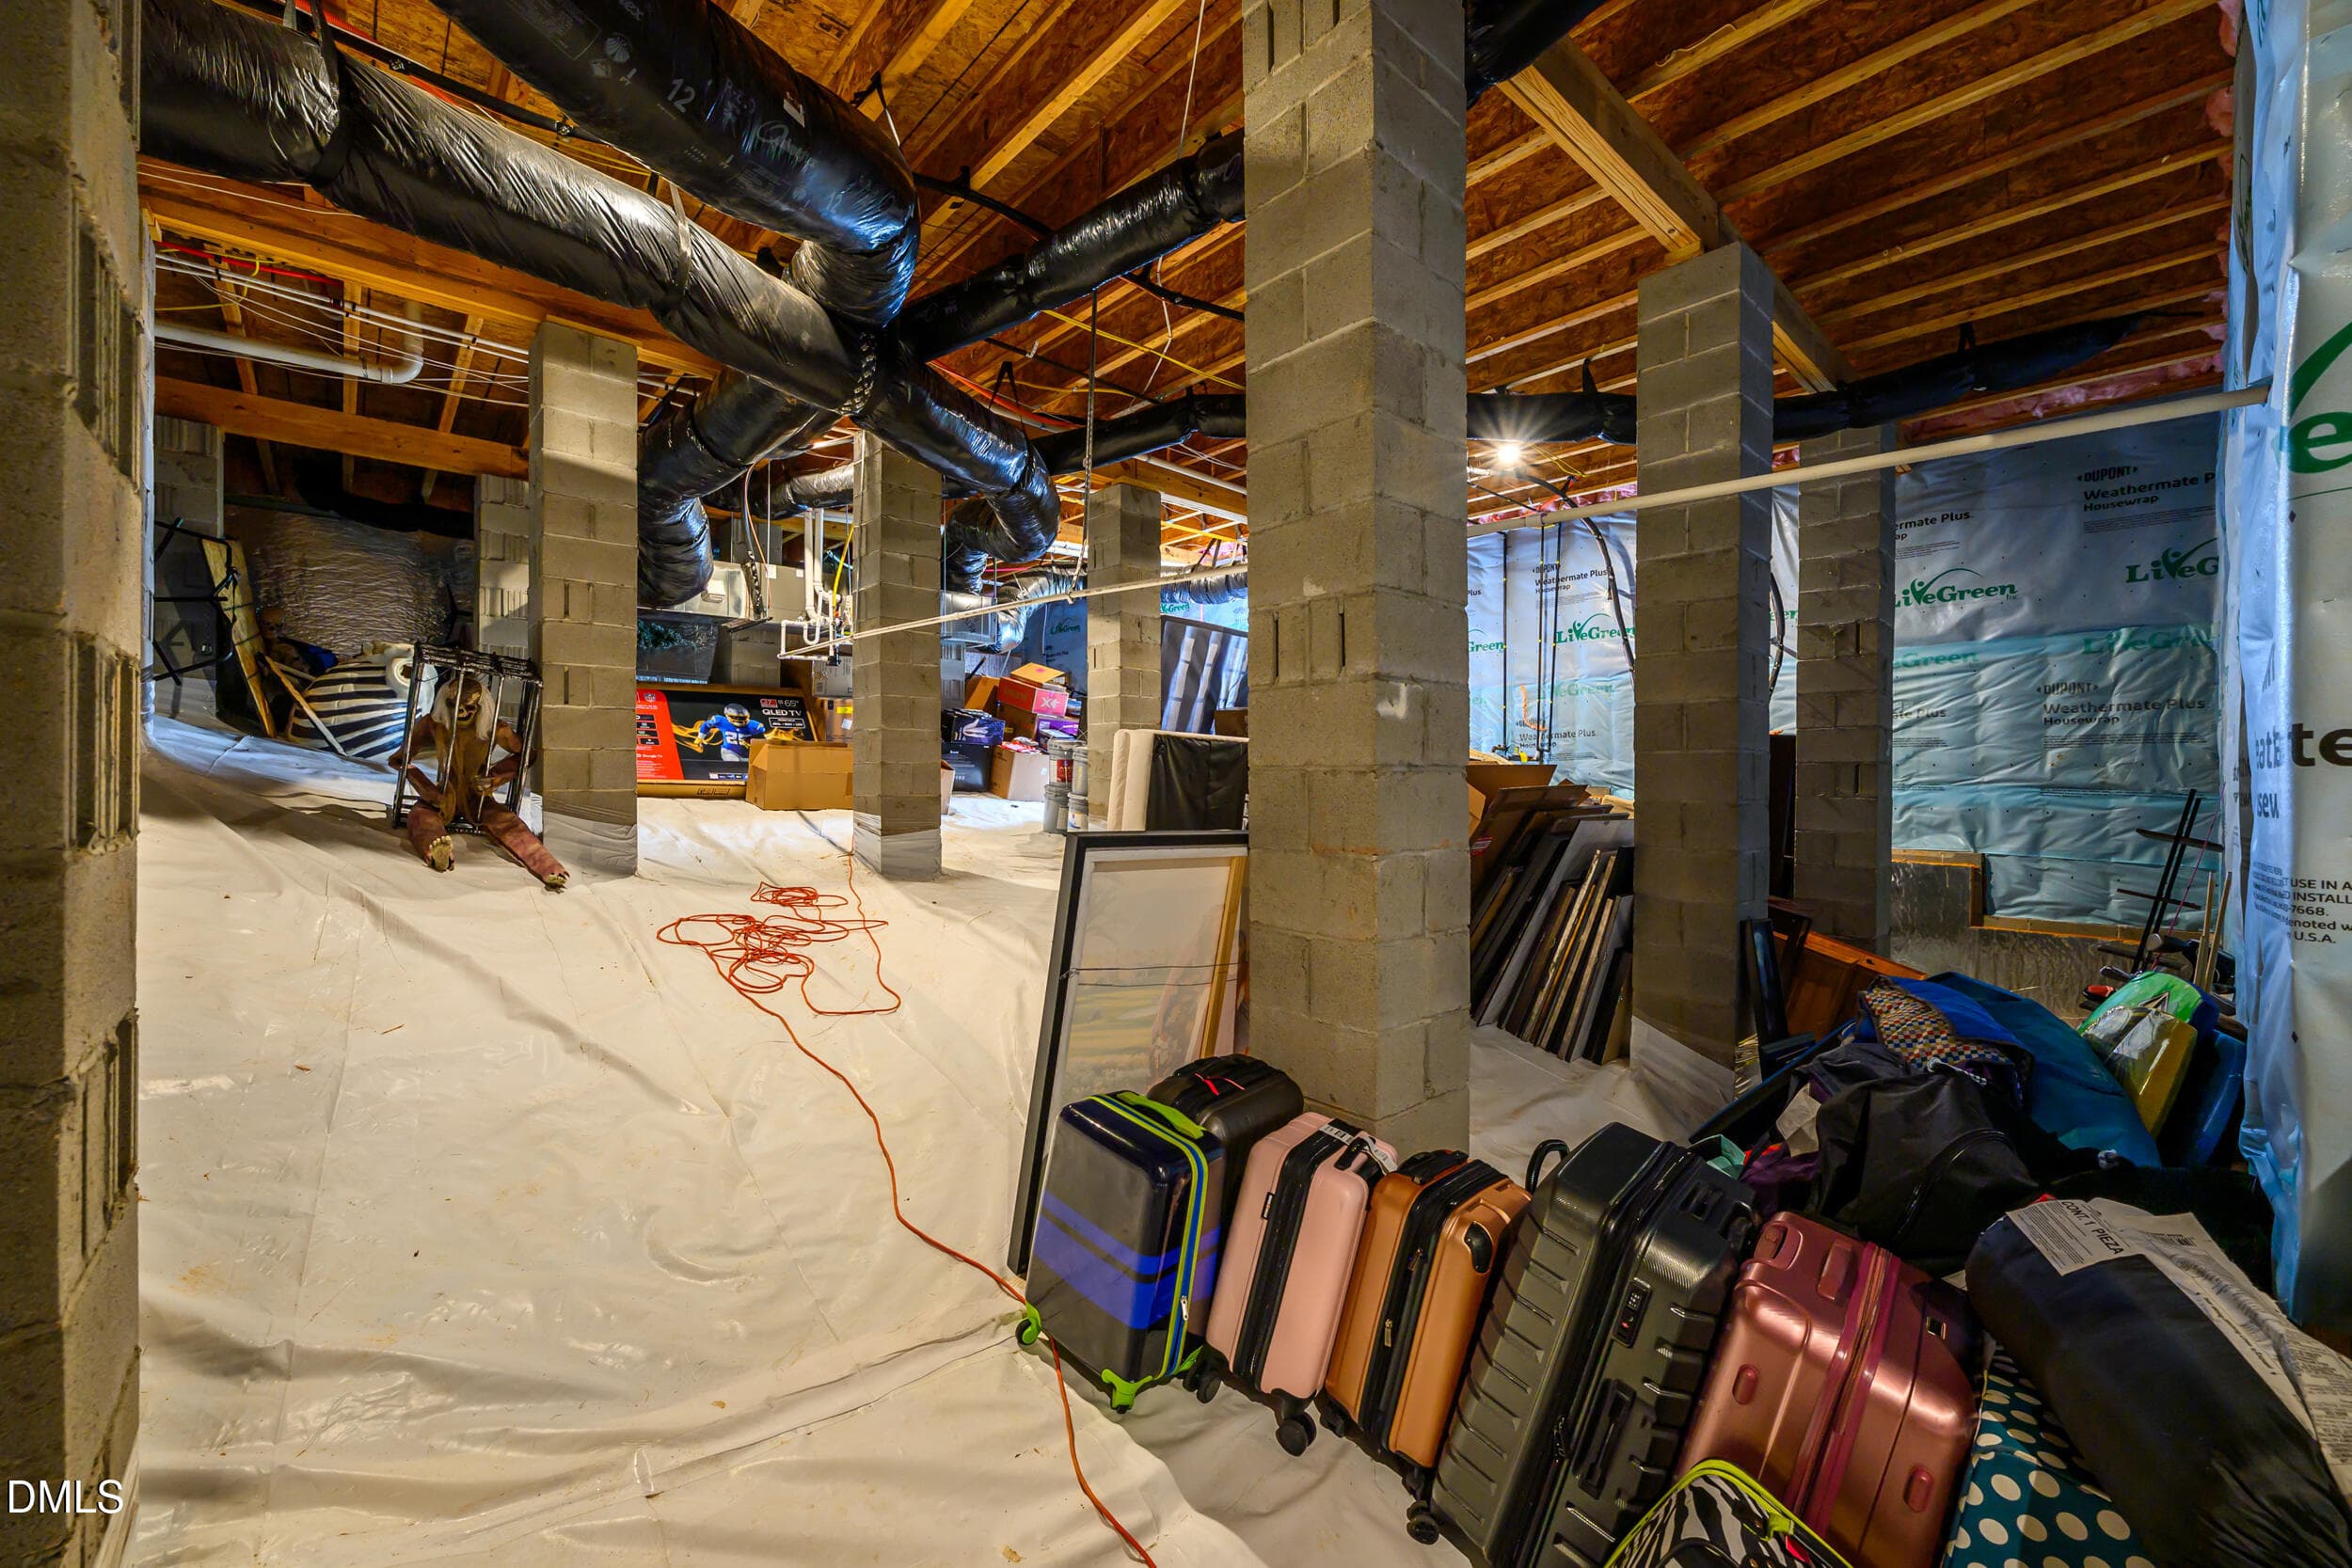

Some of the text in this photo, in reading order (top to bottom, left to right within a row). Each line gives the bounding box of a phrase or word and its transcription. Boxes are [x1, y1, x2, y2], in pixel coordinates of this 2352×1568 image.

[667, 78, 696, 114] 12
[2082, 467, 2133, 482] DUPONT
[2084, 476, 2199, 500] Weathermate
[2084, 495, 2159, 512] Housewrap
[1941, 511, 1971, 523] Plus
[2043, 698, 2206, 715] Weathermate Plus
[2043, 716, 2121, 727] Housewrap
[1578, 729, 1597, 737] Plus
[2290, 879, 2316, 889] USE
[2321, 879, 2337, 890] IN
[2294, 932, 2337, 943] U.S.A.
[2060, 1200, 2087, 1222] CONT.
[2091, 1227, 2125, 1256] PIEZA
